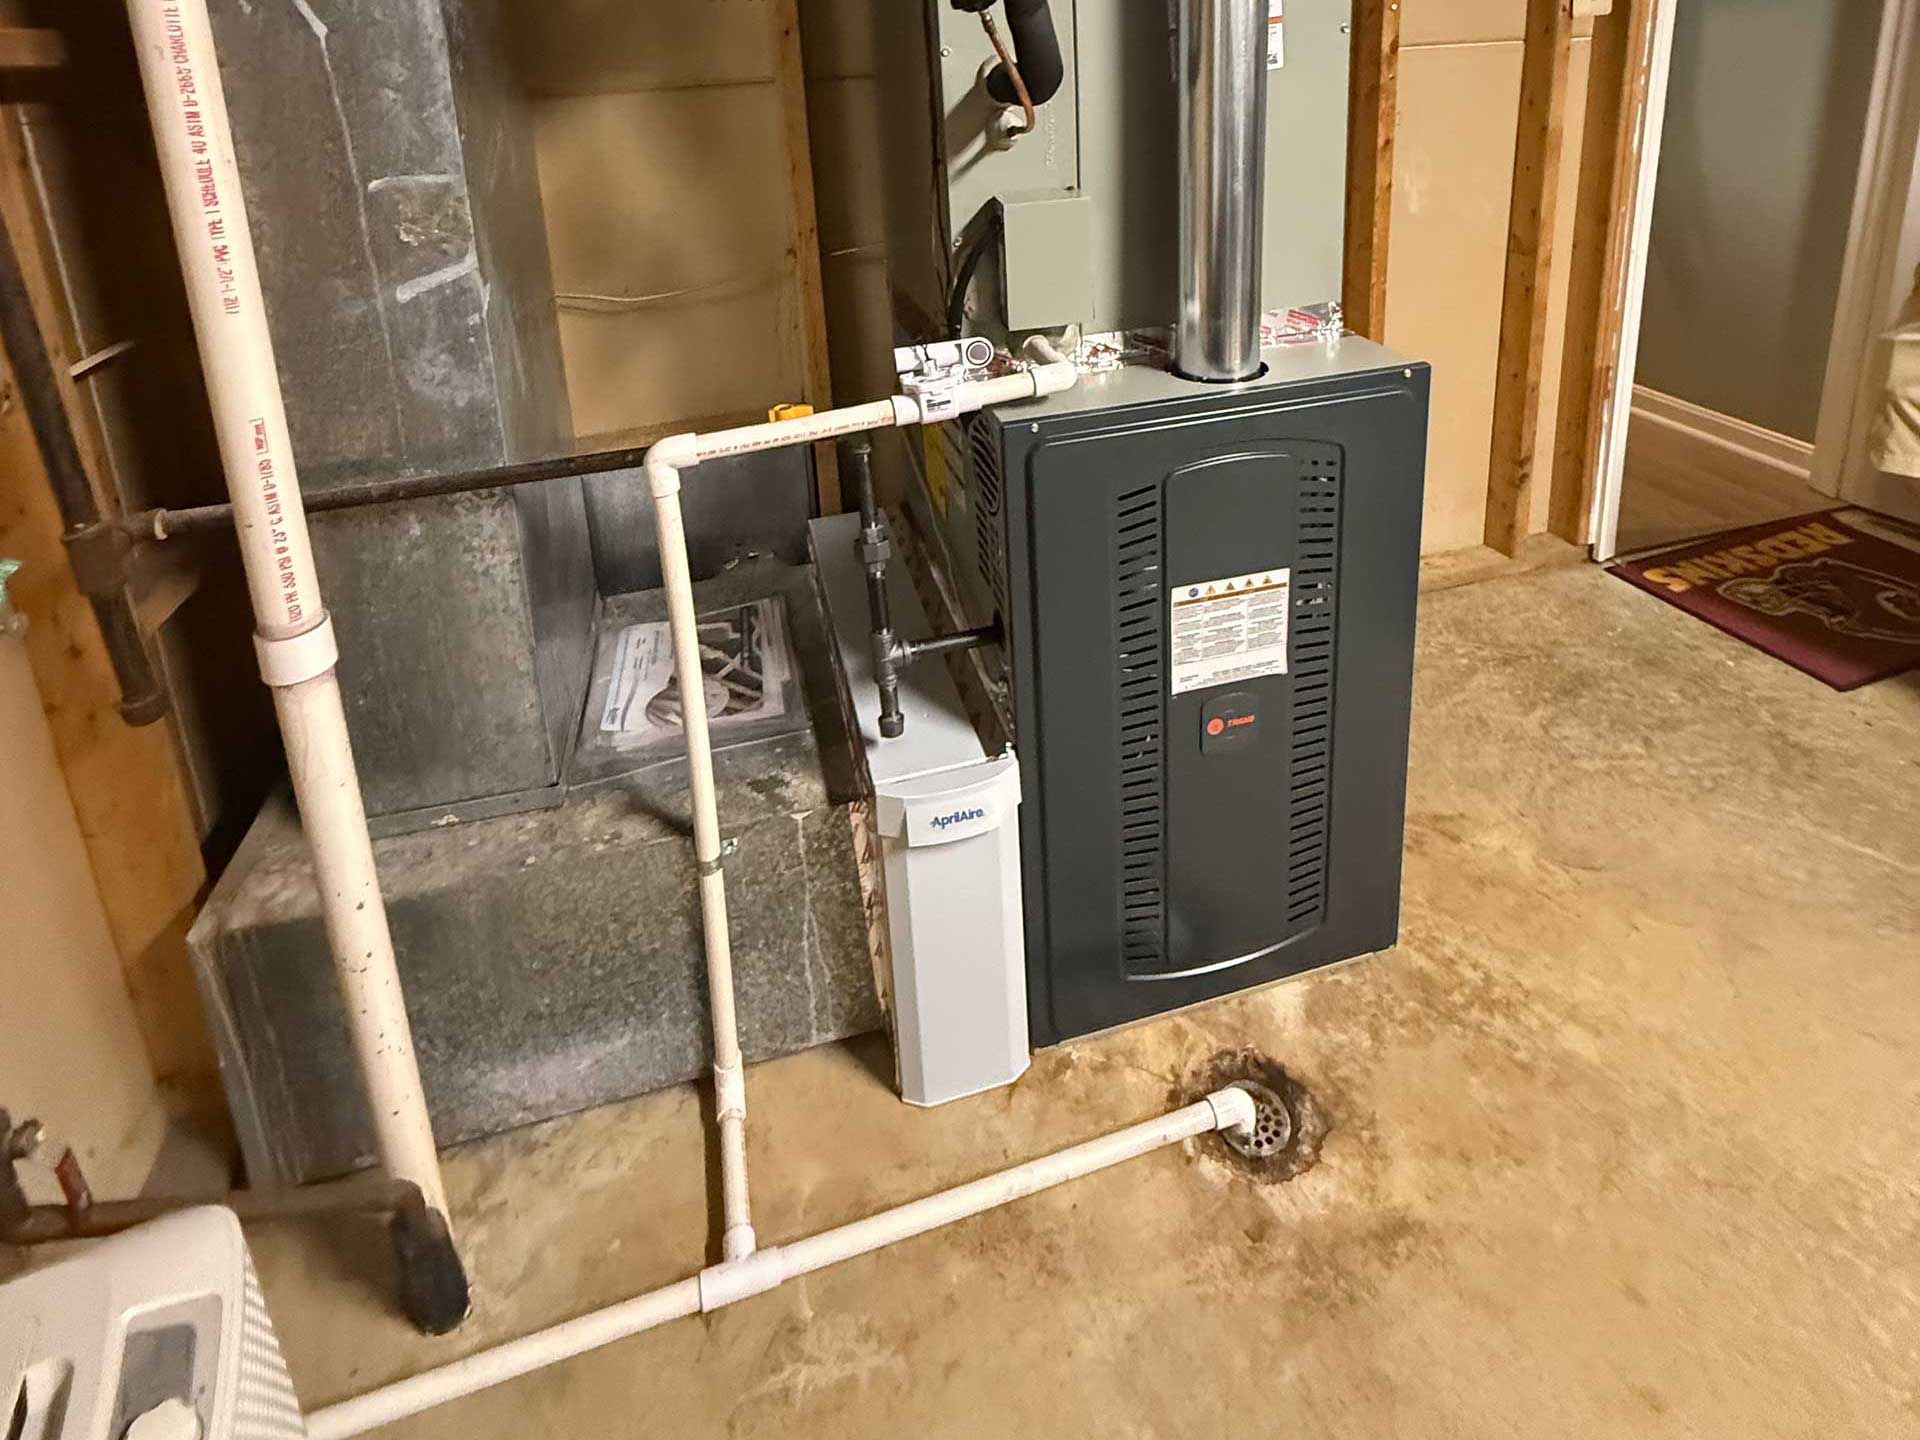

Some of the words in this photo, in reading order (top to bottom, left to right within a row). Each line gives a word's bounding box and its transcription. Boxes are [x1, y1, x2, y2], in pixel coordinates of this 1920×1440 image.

[162, 6, 190, 64] CHARLOTTE
[184, 110, 205, 138] ASTM
[196, 158, 219, 207] SCHEDULE
[208, 218, 226, 240] TYPE
[213, 245, 231, 262] PVC
[1643, 521, 1855, 593] REDSKINS
[930, 808, 984, 829] AprilAire
